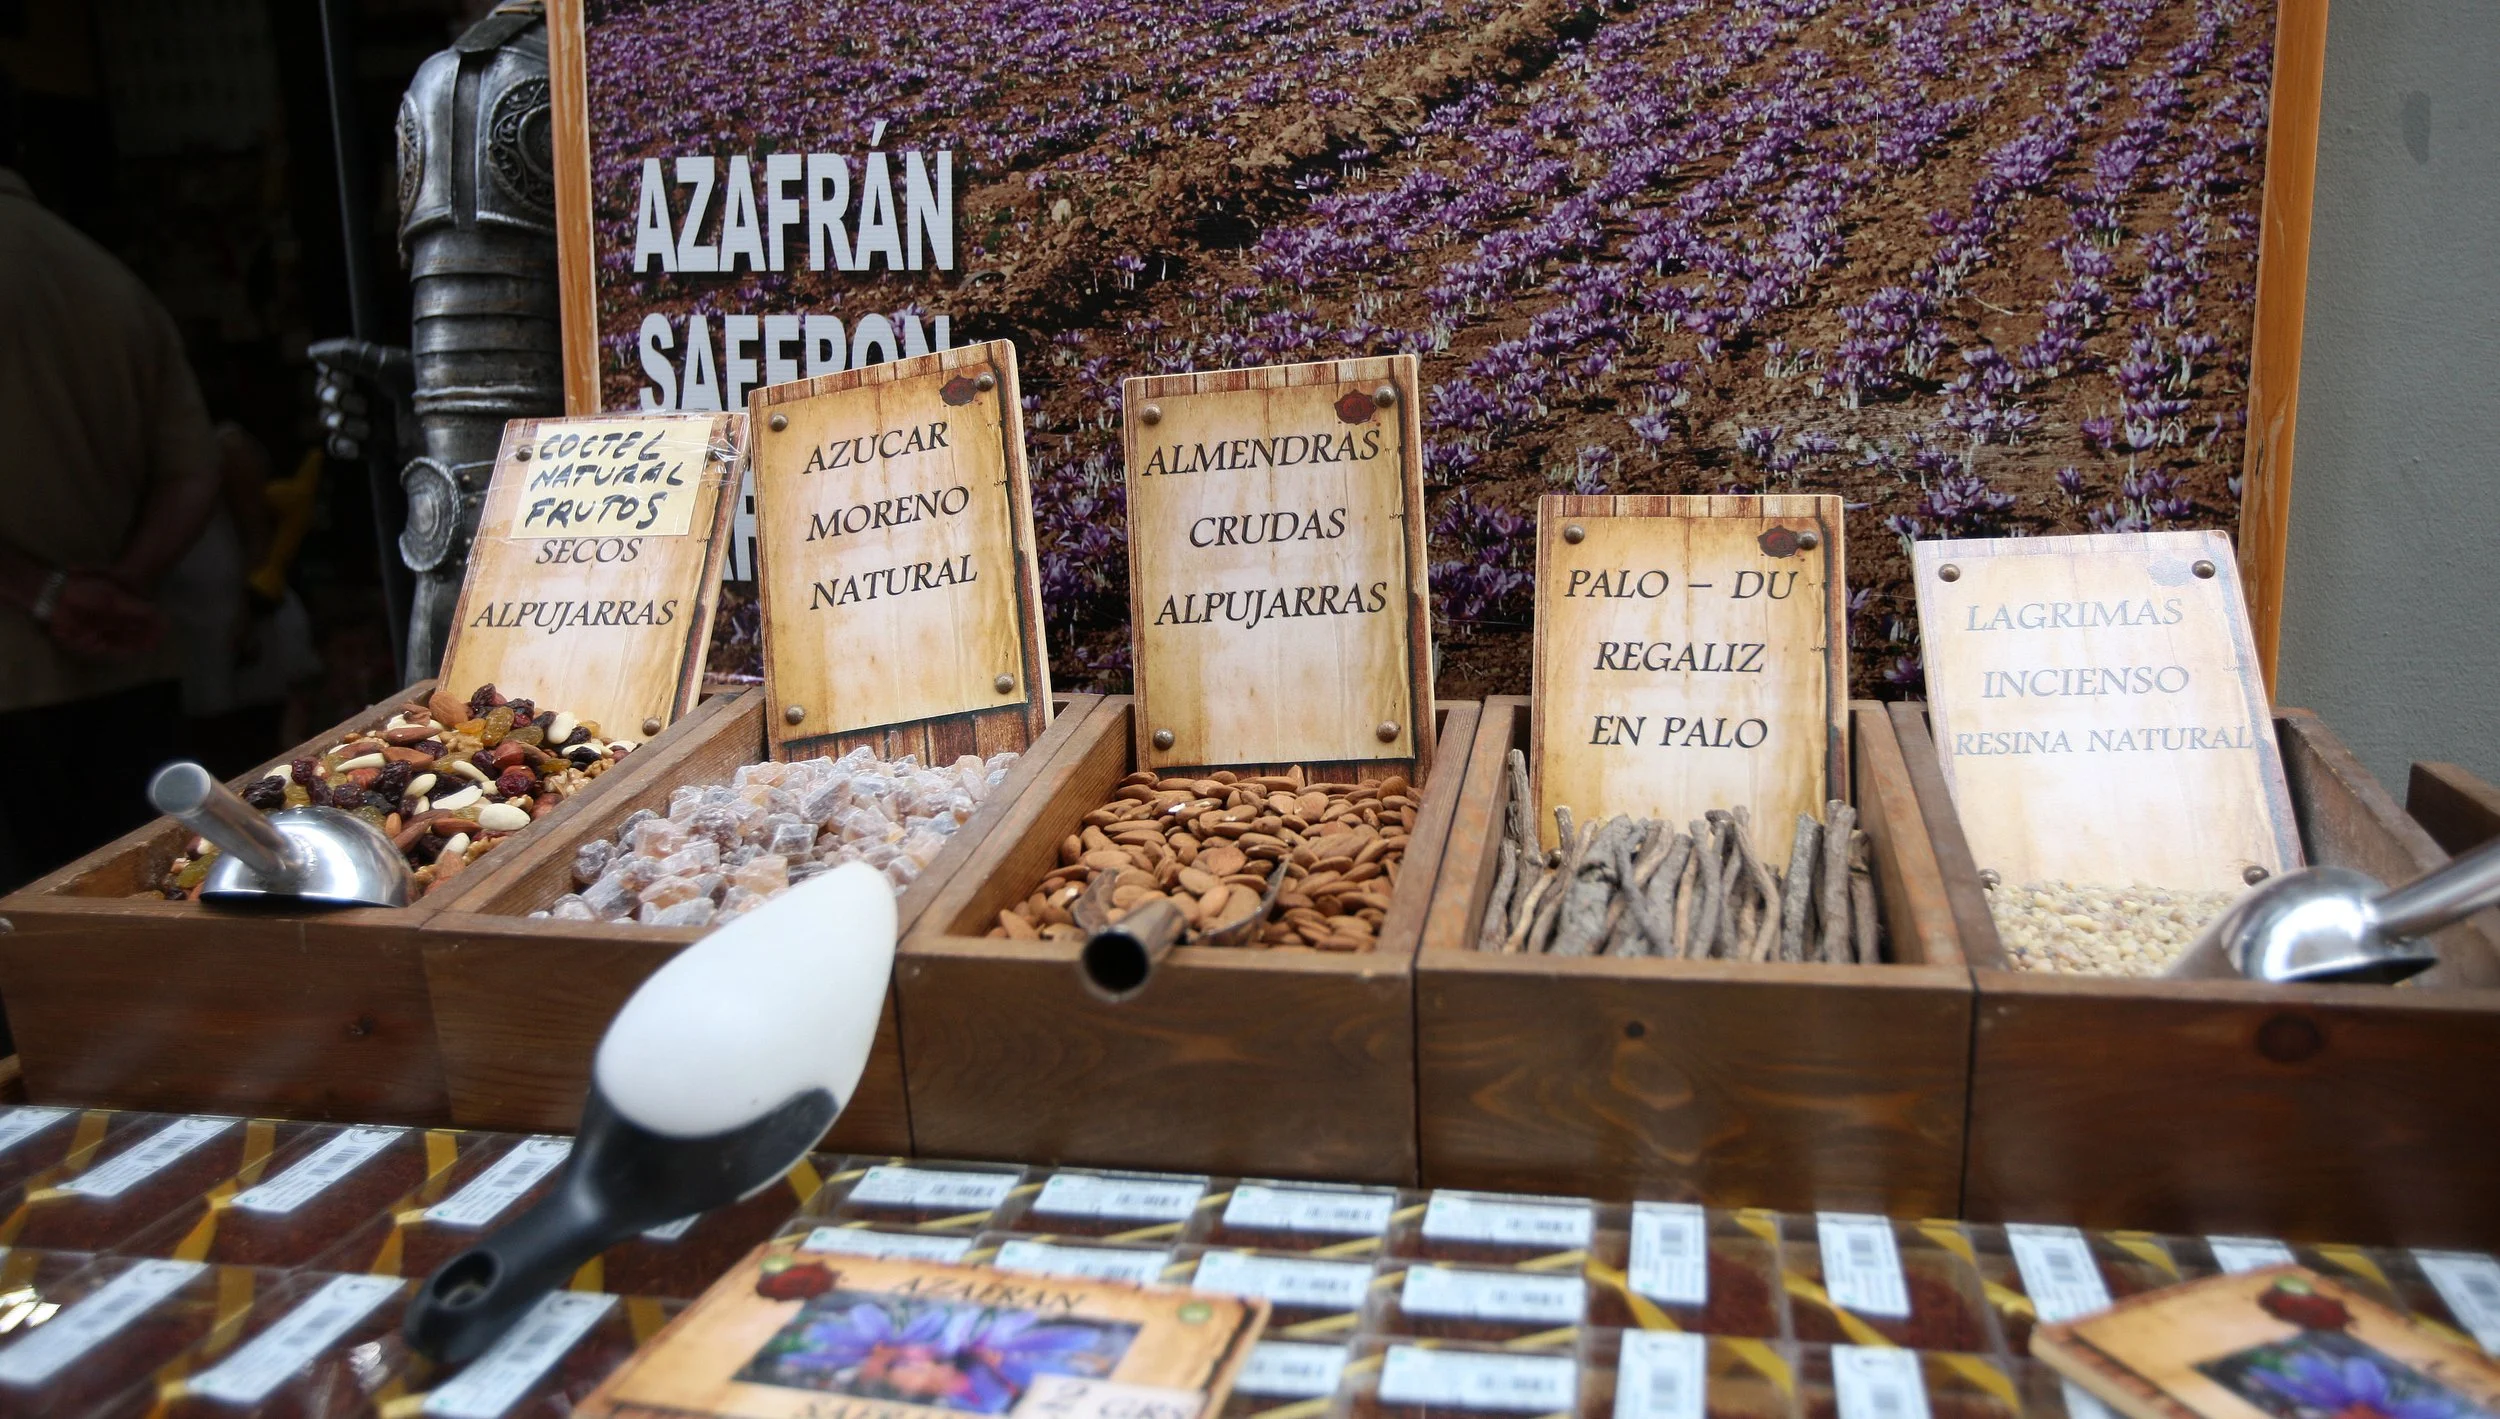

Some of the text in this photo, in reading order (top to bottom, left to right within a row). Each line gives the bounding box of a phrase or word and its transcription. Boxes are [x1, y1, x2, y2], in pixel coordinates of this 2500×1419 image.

[634, 121, 953, 272] AZAFRÁN
[539, 430, 665, 461] COCTEL
[803, 421, 949, 474] AZUCAR
[1142, 429, 1380, 477] ALMENDRAS
[530, 462, 684, 491] NATURAL
[525, 491, 668, 530] FRUTOS
[806, 485, 969, 541] MORENO
[1189, 507, 1346, 548] CRUDAS
[536, 538, 643, 565] SECOS
[810, 554, 978, 610] NATURAL
[1564, 569, 1669, 599] PALO
[1731, 570, 1798, 600] DU
[471, 600, 678, 634] ALPUJARRAS
[1154, 582, 1387, 630] ALPUJARRAS
[1965, 598, 2184, 632] LAGRIMAS
[1593, 641, 1766, 673] REGALIZ
[1981, 665, 2190, 698] INCIENSO
[1589, 715, 1768, 748] EN PALO
[1954, 726, 2255, 756] RESINA NATURAL
